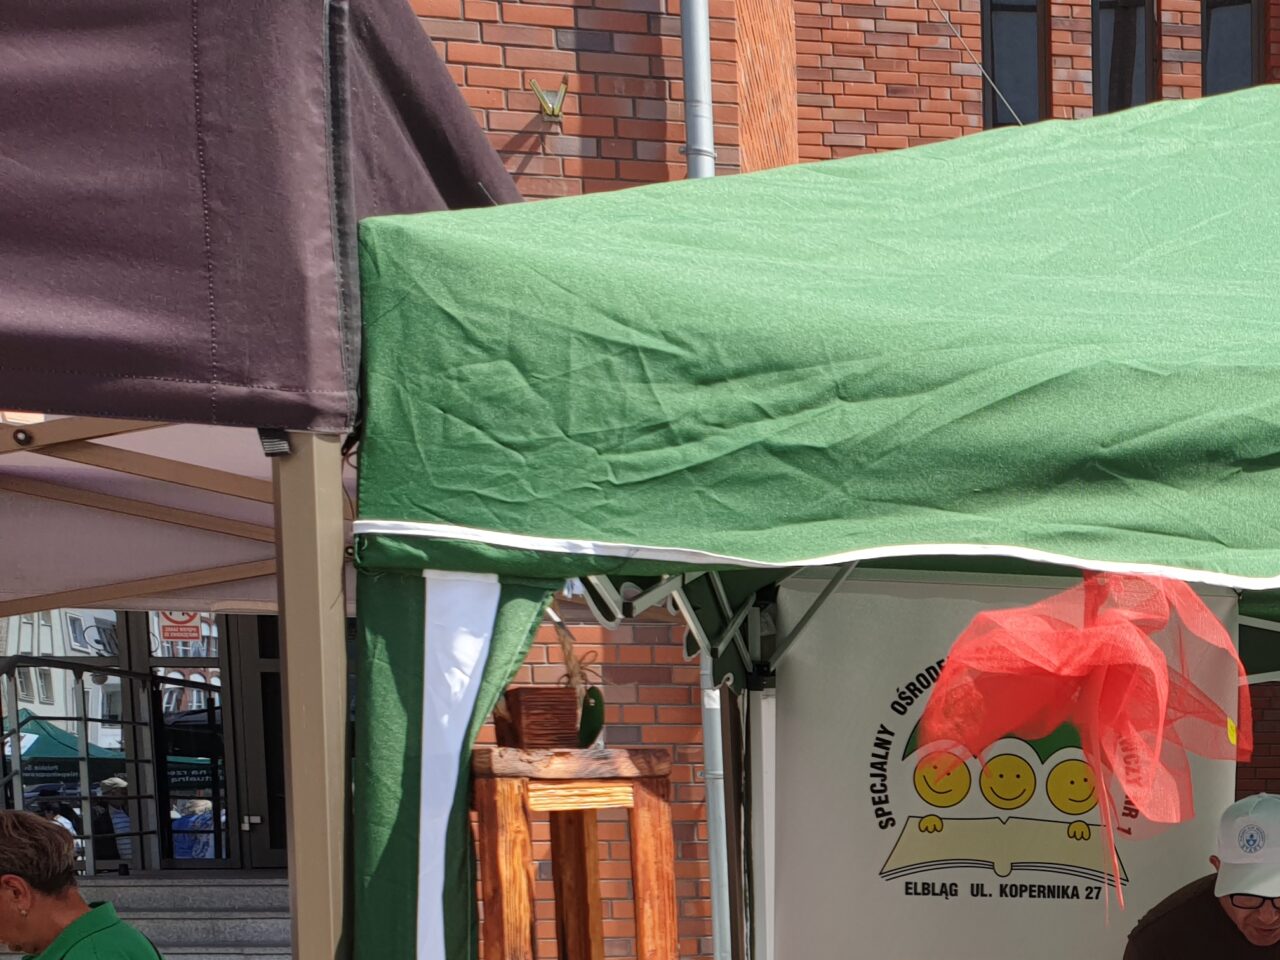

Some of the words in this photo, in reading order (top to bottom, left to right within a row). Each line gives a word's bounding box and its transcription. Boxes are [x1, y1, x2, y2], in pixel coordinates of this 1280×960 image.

[869, 723, 896, 830] SPECJALNY
[890, 655, 951, 716] OŚRODE
[904, 881, 959, 900] ELBLĄG
[970, 883, 993, 898] UL.
[999, 884, 1080, 899] KOPERNIKA
[1084, 886, 1102, 900] 27
